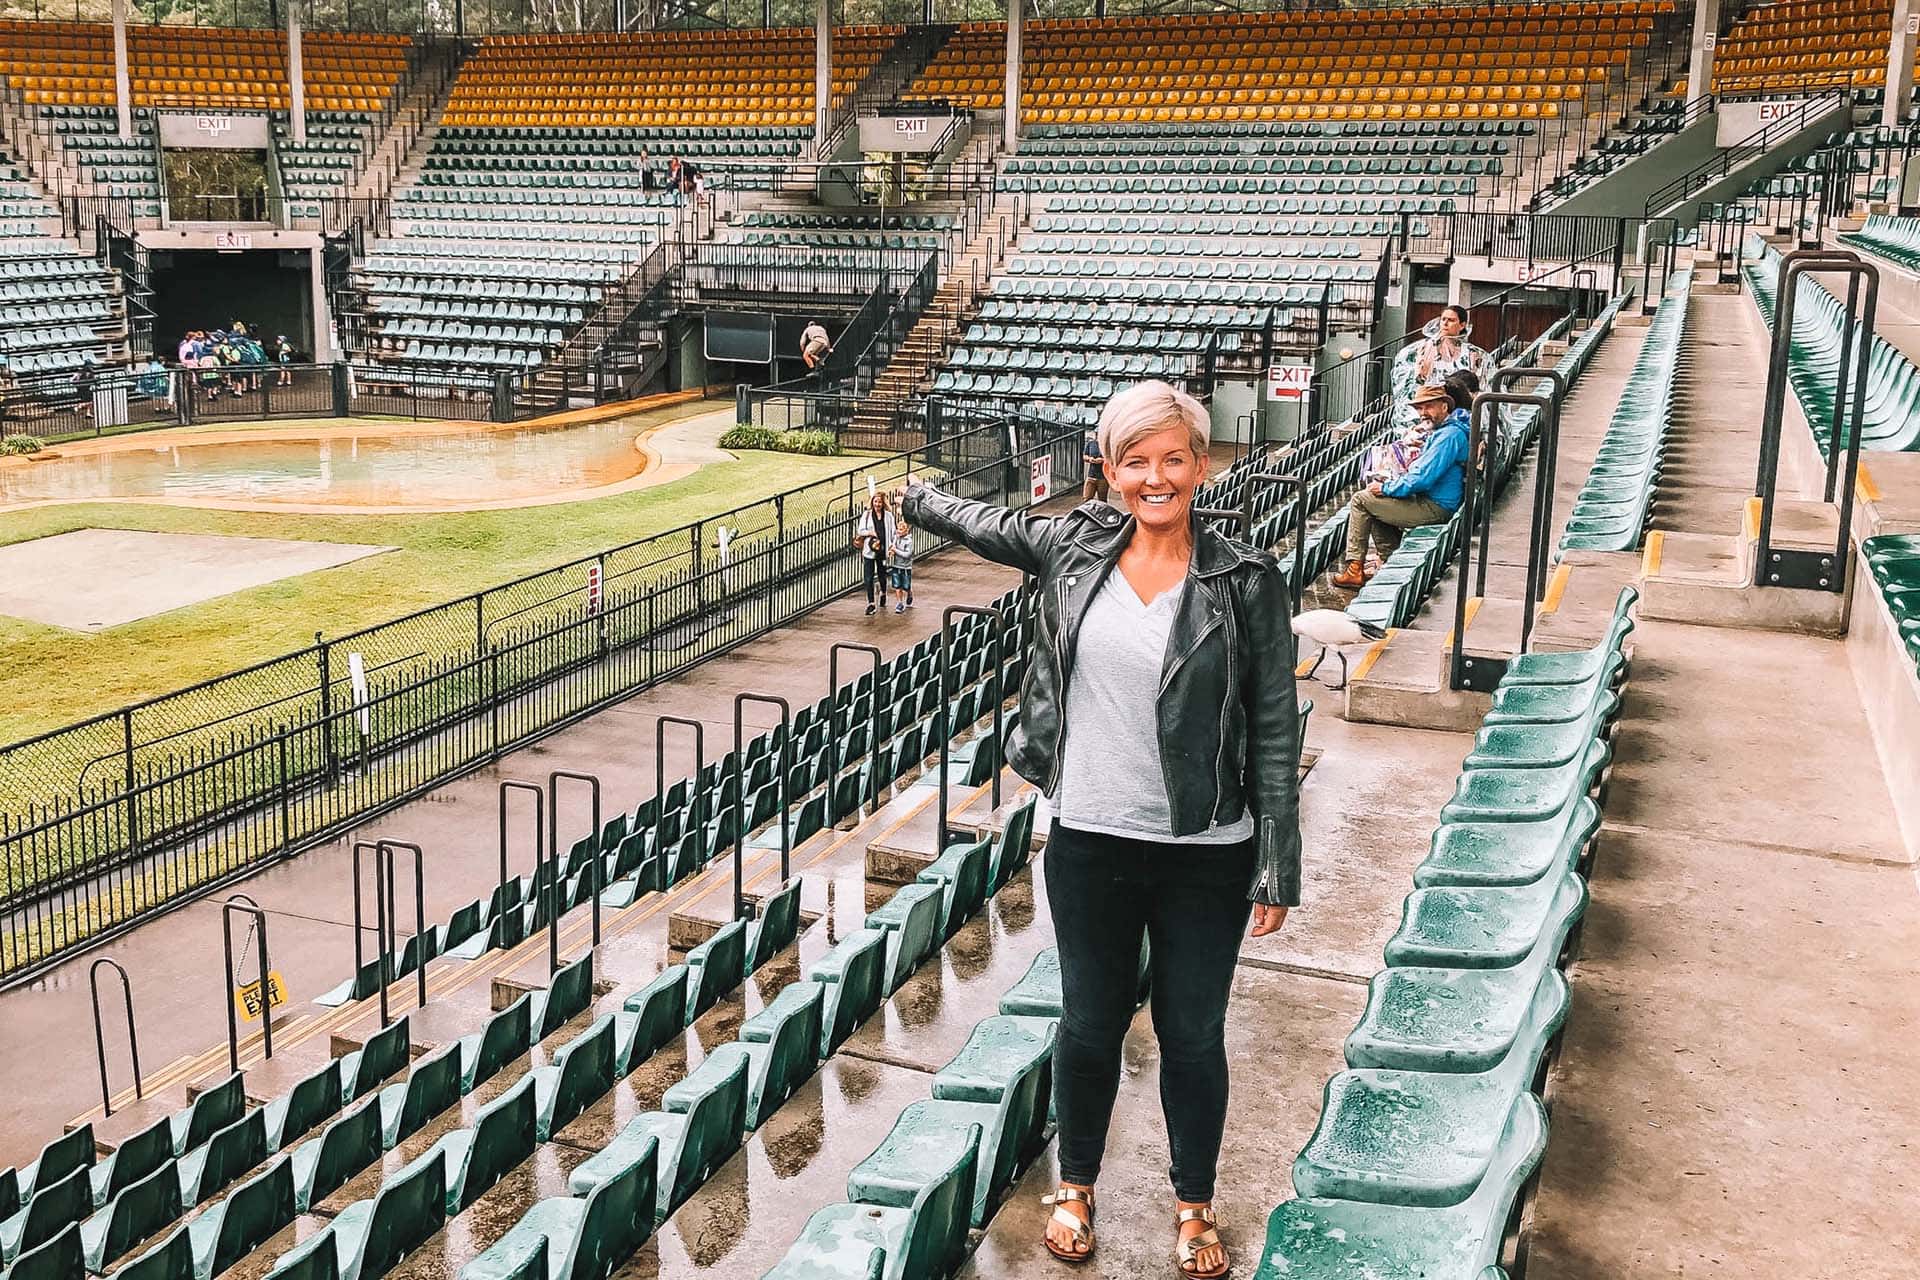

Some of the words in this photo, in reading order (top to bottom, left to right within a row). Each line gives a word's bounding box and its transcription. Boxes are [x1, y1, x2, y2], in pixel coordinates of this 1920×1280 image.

[1760, 104, 1795, 119] EXIT
[198, 118, 228, 129] EXIT
[896, 119, 926, 131] EXIT
[216, 236, 248, 248] EXIT
[1270, 367, 1312, 382] EXIT
[1032, 456, 1050, 480] EXIT
[246, 988, 280, 1014] EXT
